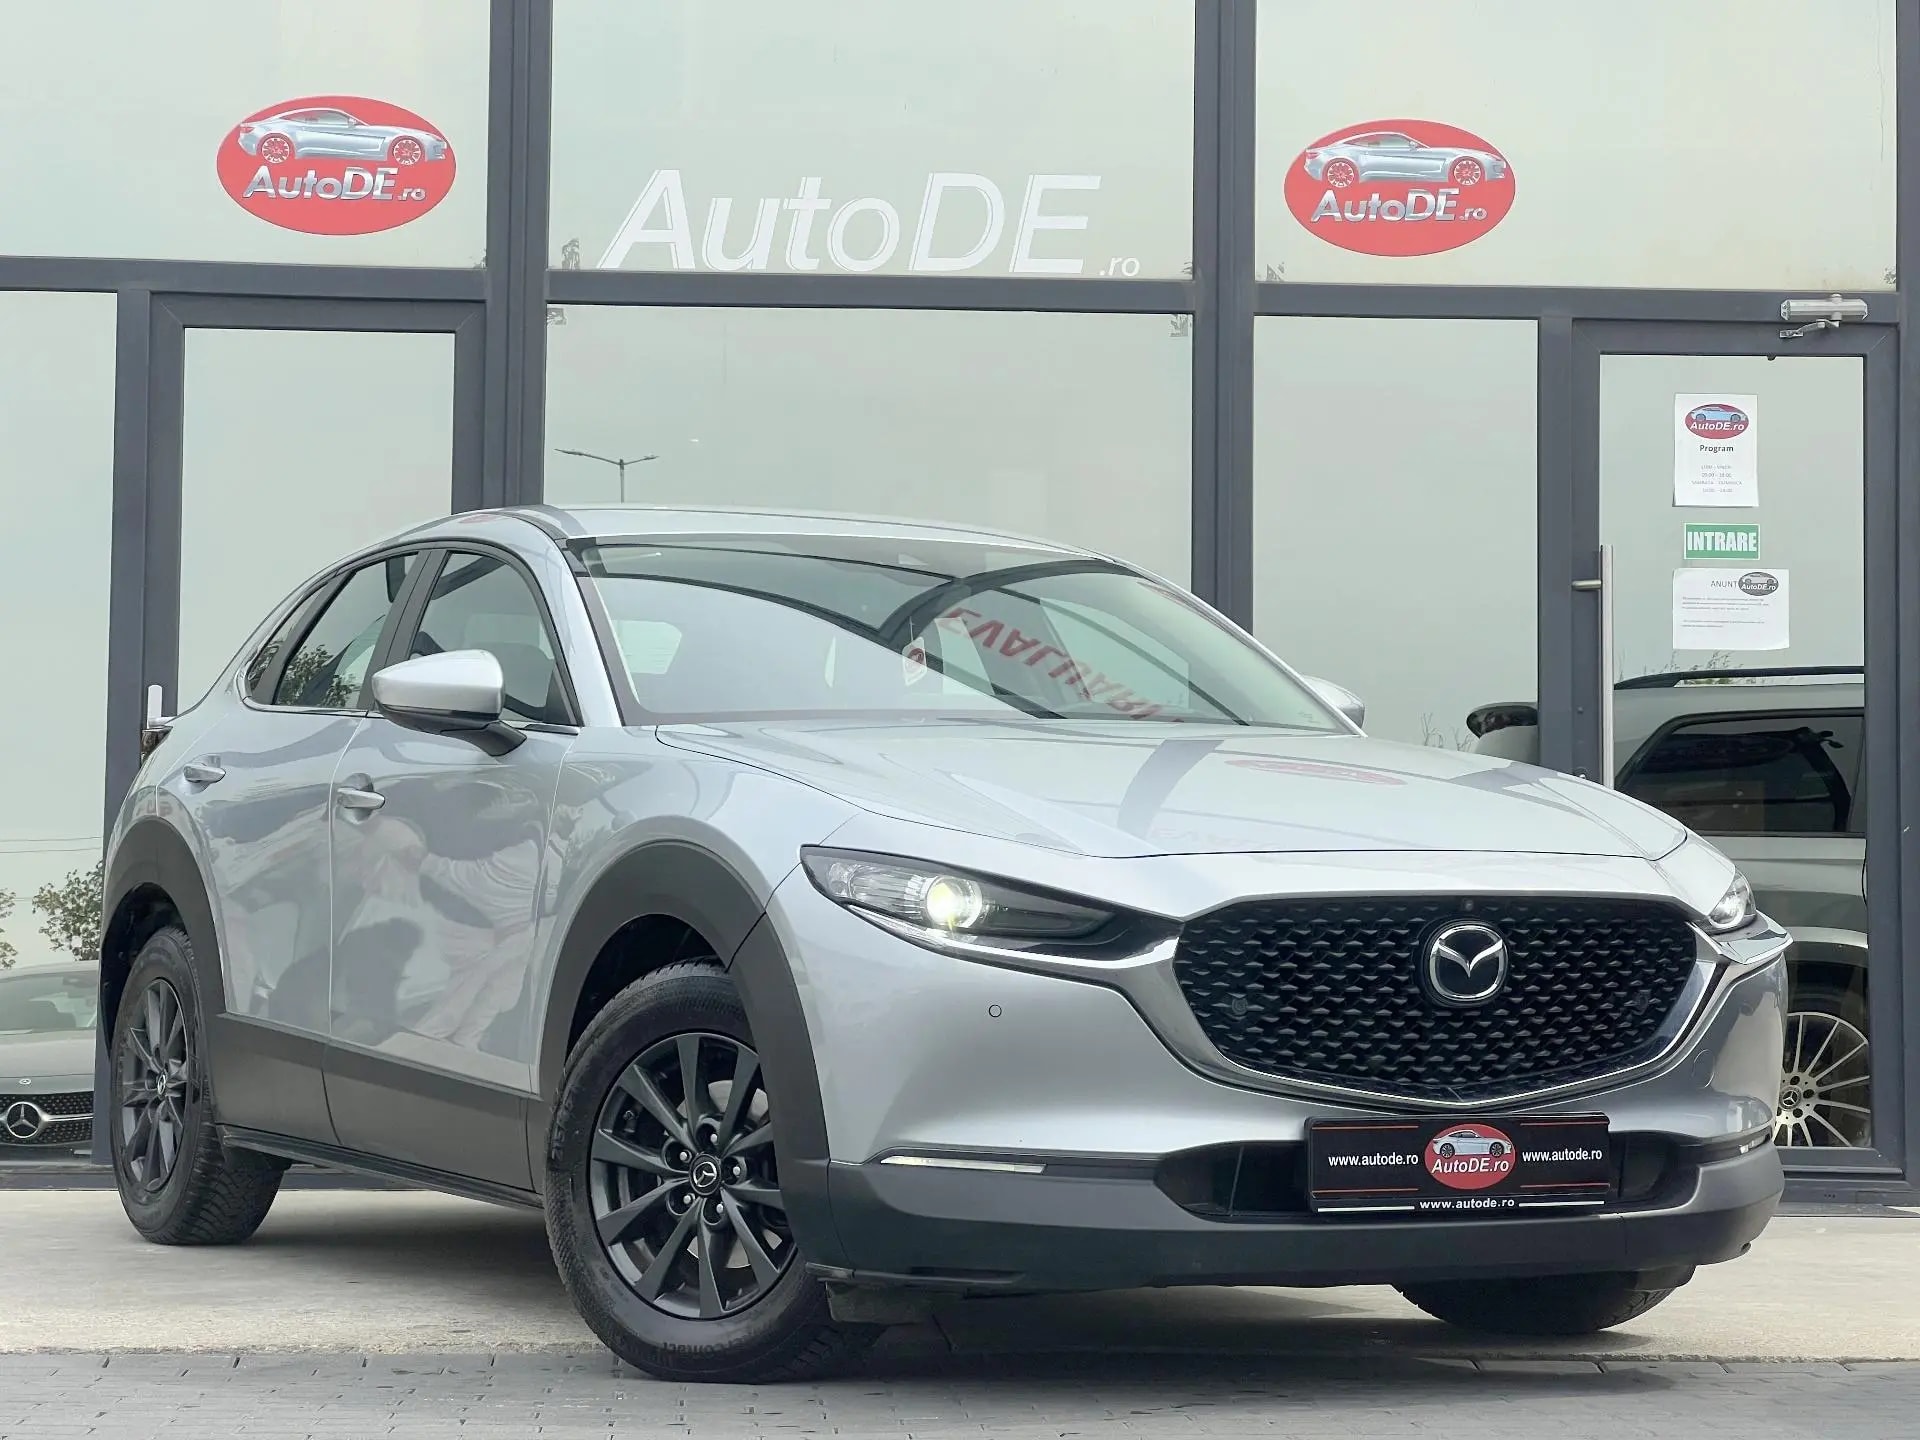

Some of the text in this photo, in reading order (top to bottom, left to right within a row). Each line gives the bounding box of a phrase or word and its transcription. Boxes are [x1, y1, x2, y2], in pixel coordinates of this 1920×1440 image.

[1689, 421, 1745, 431] AutoDE.ro
[1699, 444, 1734, 454] Program
[1687, 531, 1757, 551] INTRARE
[1328, 1154, 1419, 1167] www.autode.ro
[1522, 1148, 1603, 1162] www.autode.ro
[1431, 1157, 1510, 1174] AutoDE.ro
[1419, 1198, 1515, 1209] www.autode.ro
